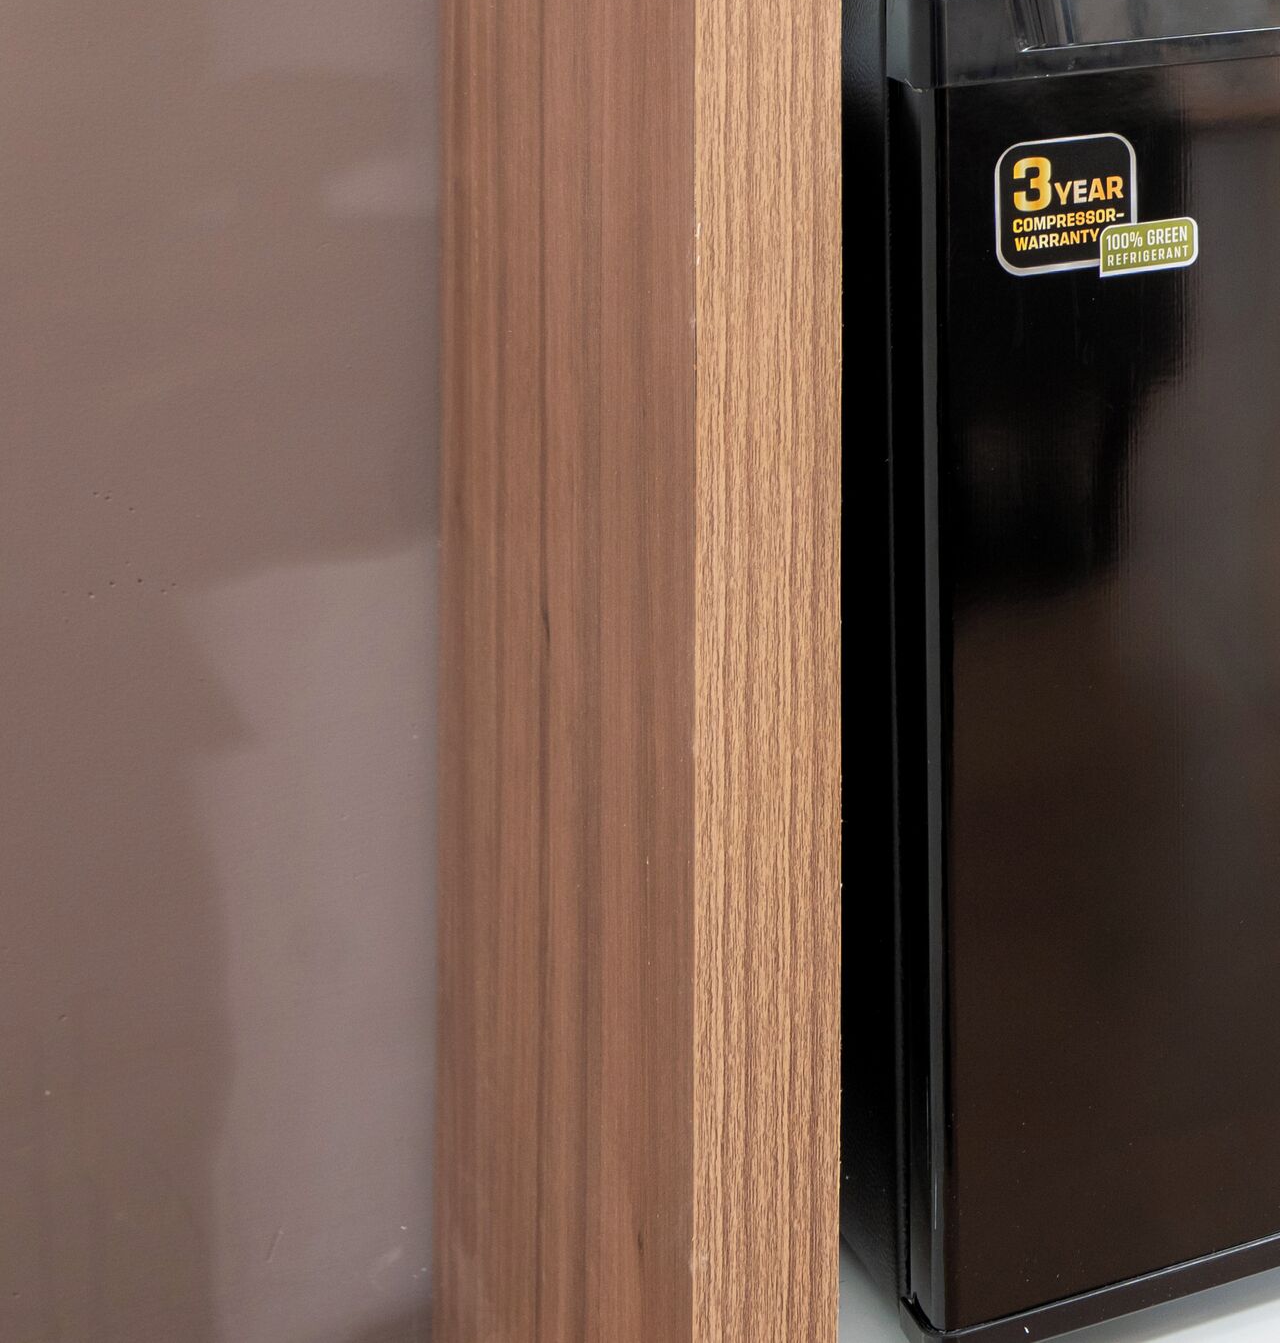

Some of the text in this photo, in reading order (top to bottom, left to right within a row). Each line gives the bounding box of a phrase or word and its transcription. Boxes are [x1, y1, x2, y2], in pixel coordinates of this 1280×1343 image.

[1012, 156, 1125, 212] 3 YEAR
[1012, 207, 1126, 234] COMPRESSOR-
[1015, 227, 1100, 252] WARRANTY
[1106, 225, 1188, 252] 100% GREEN
[1107, 245, 1190, 267] REFRIGERANT
